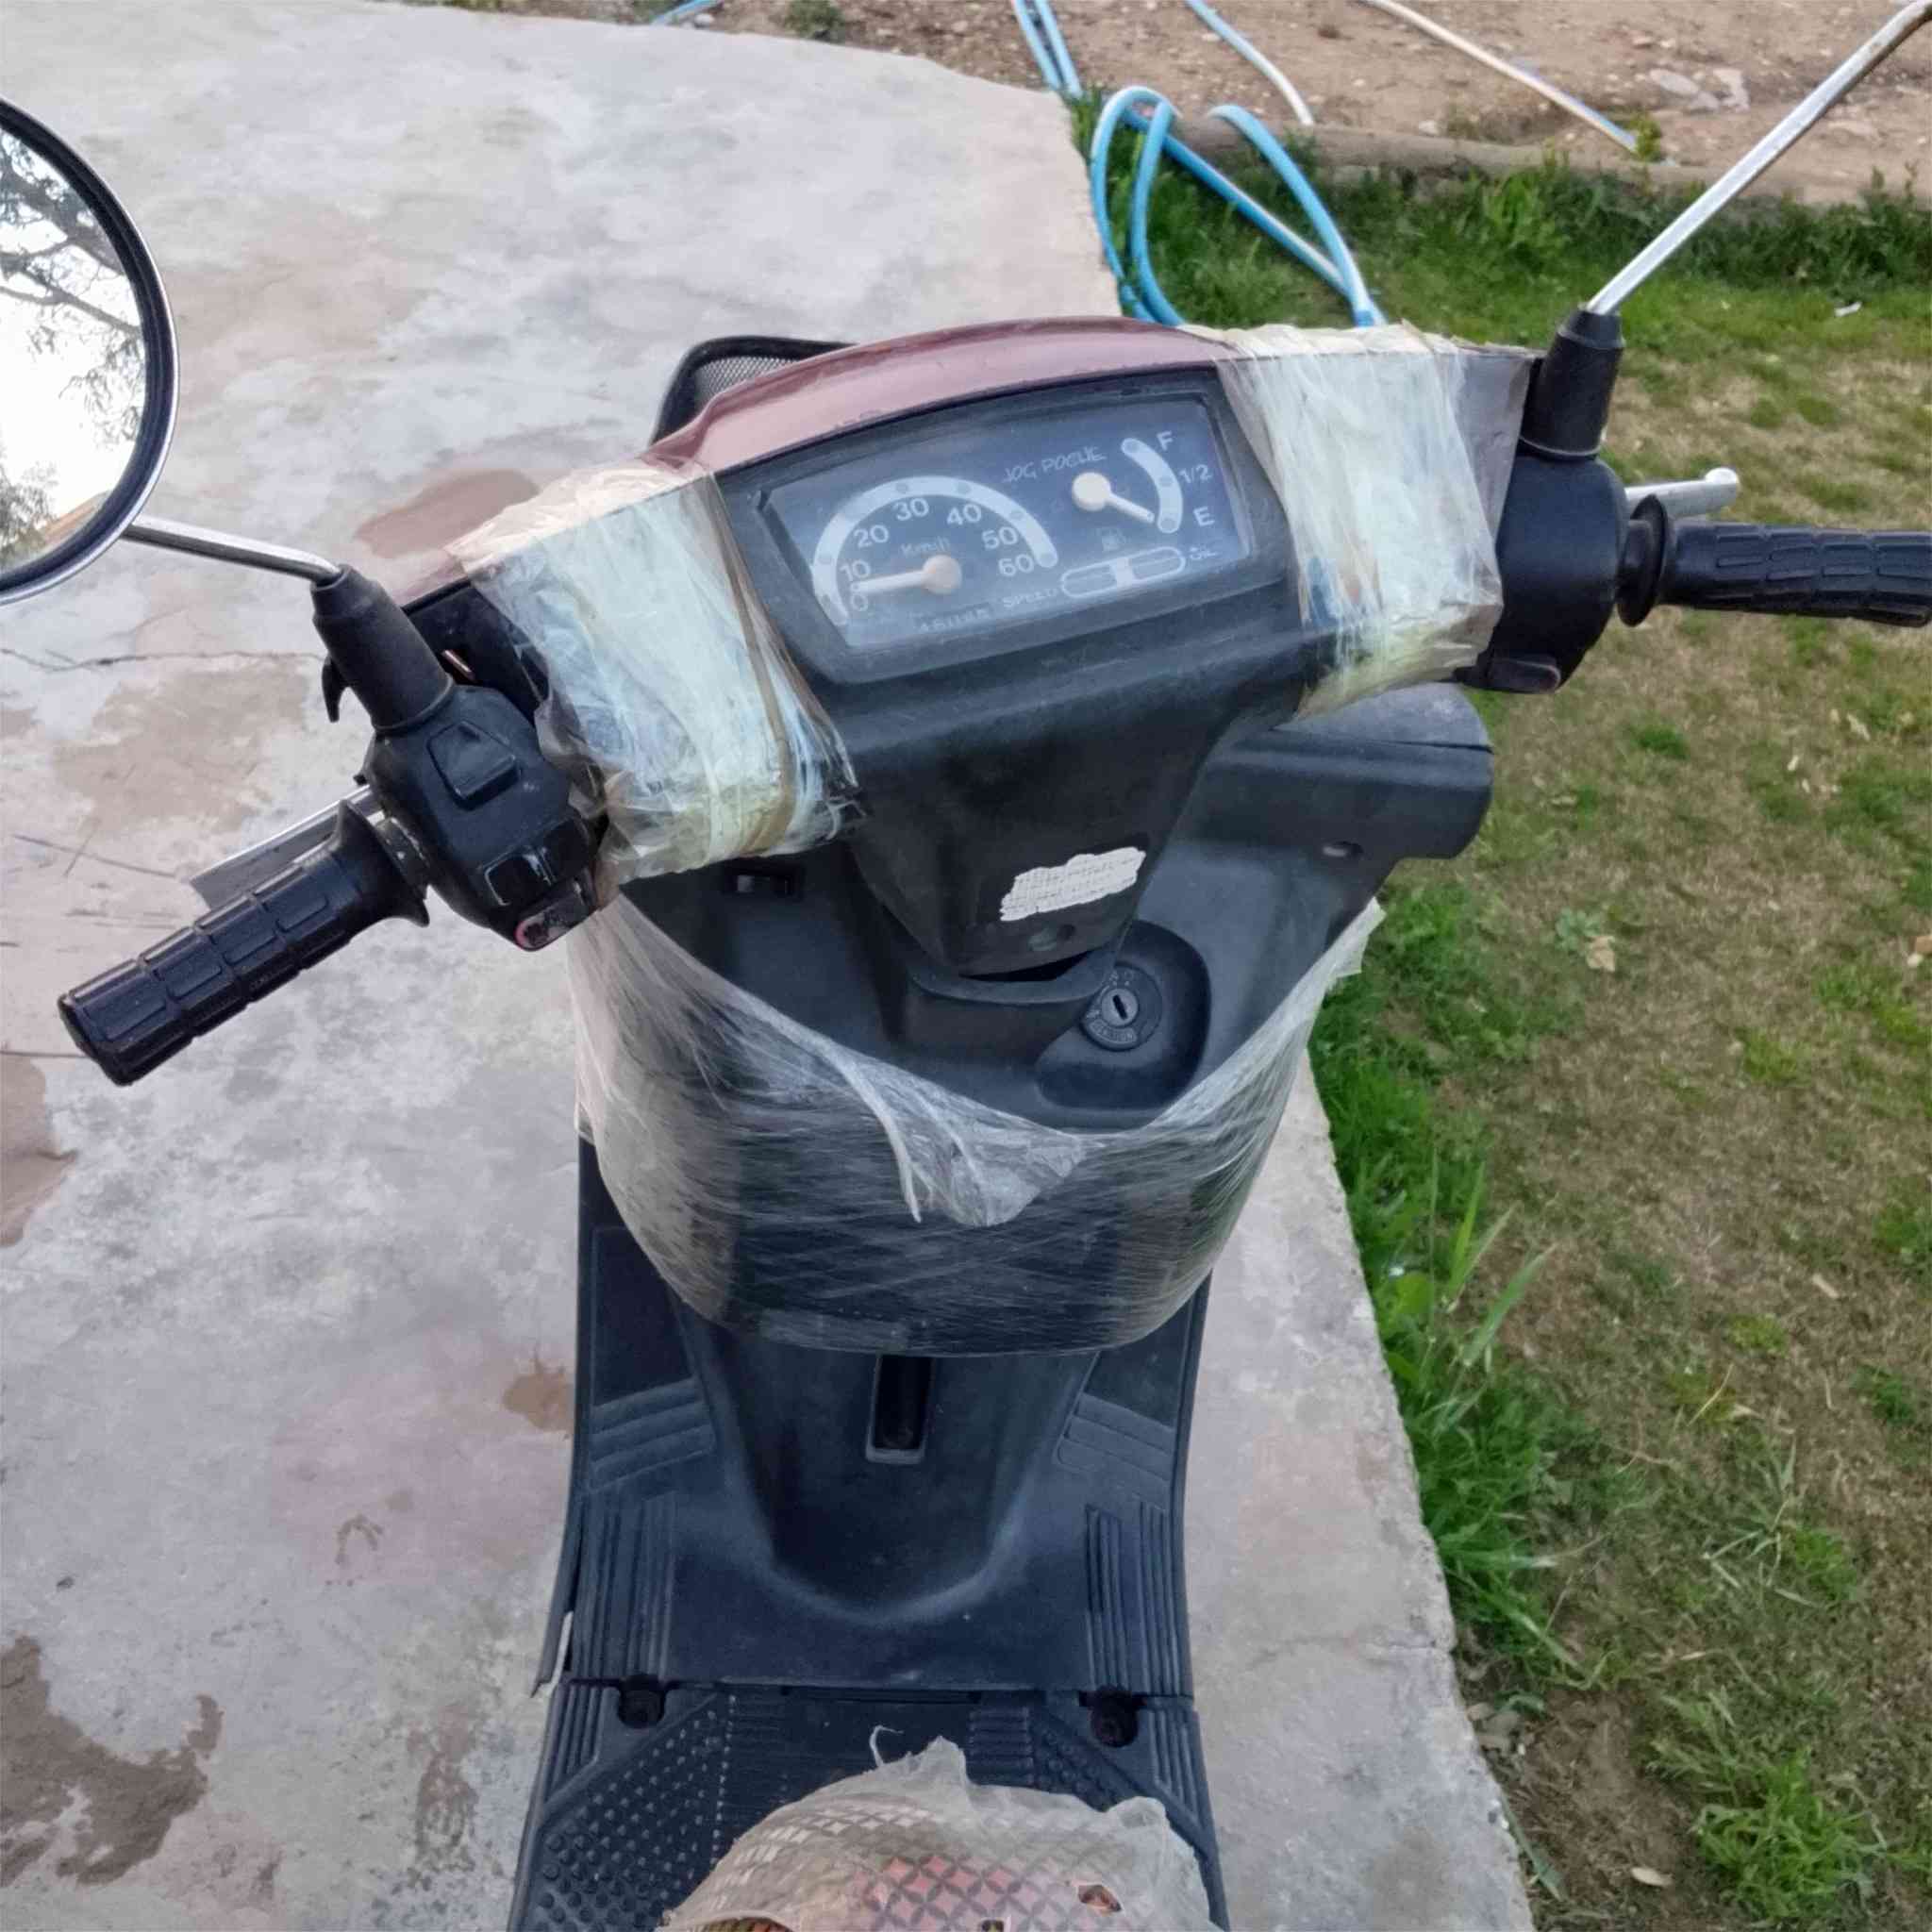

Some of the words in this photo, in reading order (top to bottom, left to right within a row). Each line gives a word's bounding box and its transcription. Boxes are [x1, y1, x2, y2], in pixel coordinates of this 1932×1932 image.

[1157, 430, 1174, 451] F
[1179, 463, 1212, 484] 1/2
[894, 497, 929, 521] 30
[946, 503, 982, 526] 40
[1192, 506, 1215, 527] E
[853, 525, 890, 548] 20
[981, 525, 1018, 550] 50
[839, 559, 872, 582] 10
[997, 553, 1035, 577] 60
[850, 592, 869, 612] 0
